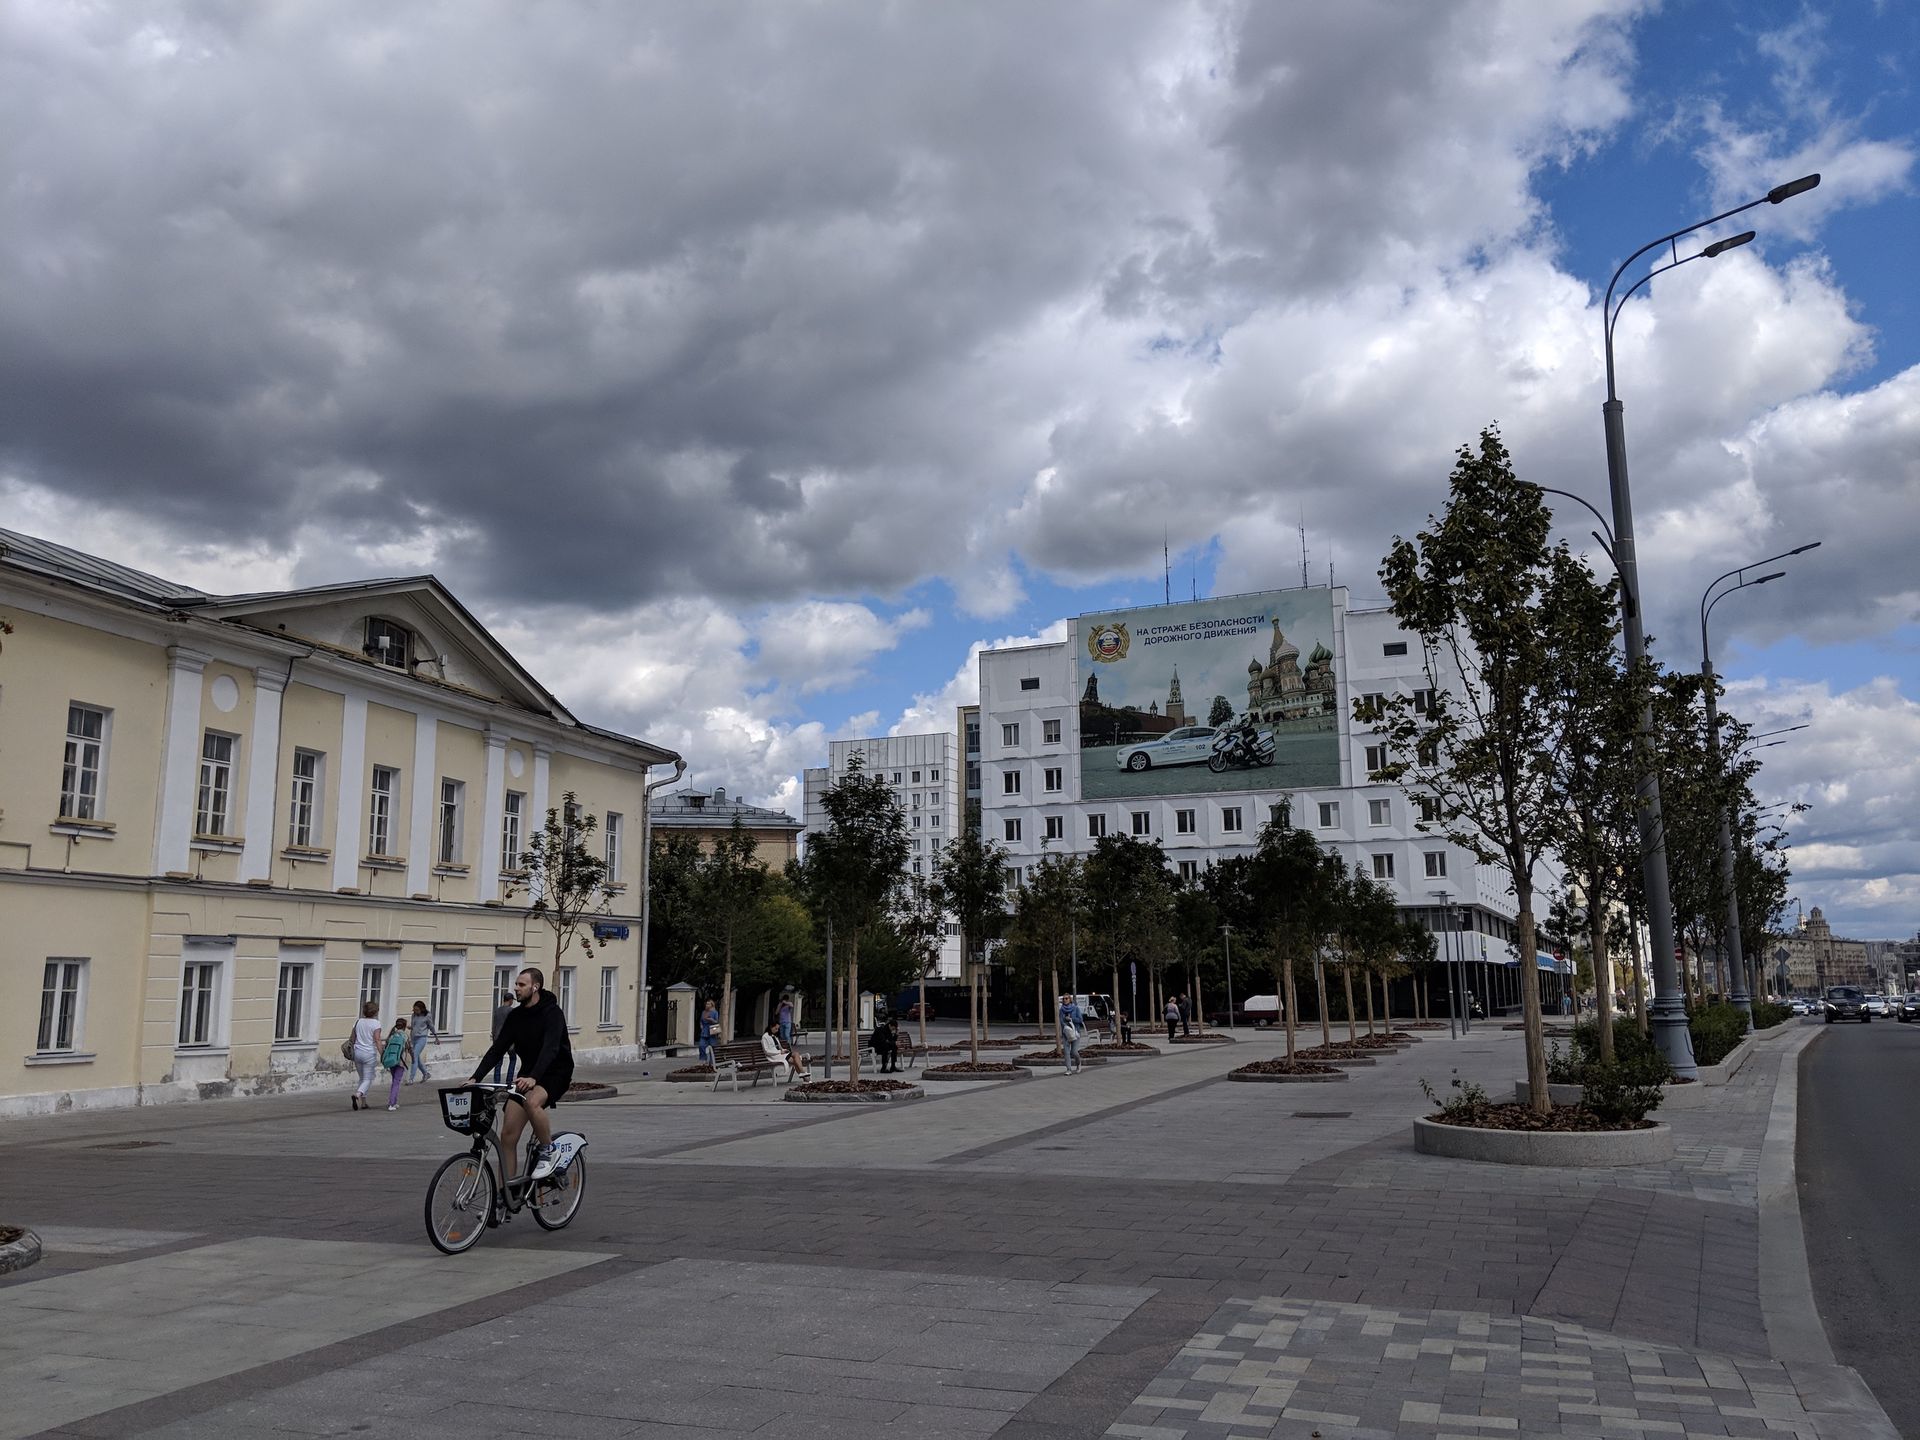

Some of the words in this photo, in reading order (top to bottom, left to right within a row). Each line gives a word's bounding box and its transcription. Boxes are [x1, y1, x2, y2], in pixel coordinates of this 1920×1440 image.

[1136, 628, 1149, 637] НА
[1151, 623, 1187, 635] СТРАЖЕ
[1189, 615, 1265, 631] БЕЗОПАСНОСТИ
[1144, 632, 1202, 646] ДОРОЖНОГО
[1203, 626, 1257, 640] ДВИЖЕНИЯ
[1195, 743, 1206, 751] 102
[455, 1097, 469, 1106] ВТБ
[560, 1142, 573, 1153] ВТБ
